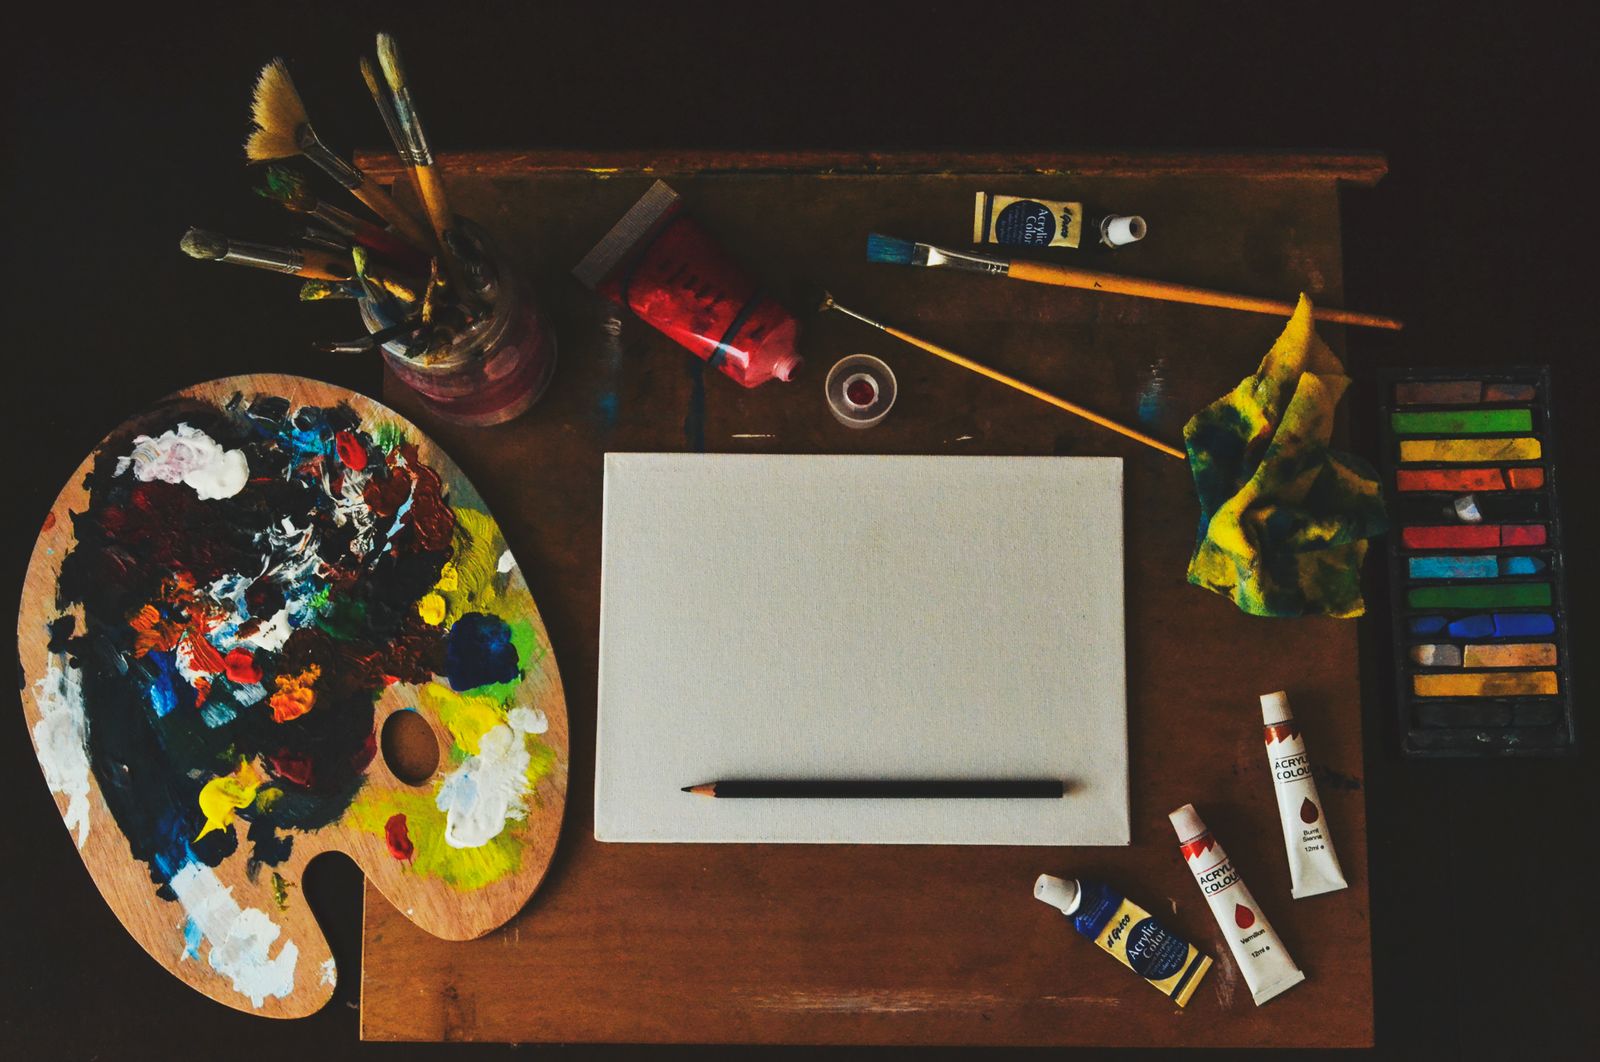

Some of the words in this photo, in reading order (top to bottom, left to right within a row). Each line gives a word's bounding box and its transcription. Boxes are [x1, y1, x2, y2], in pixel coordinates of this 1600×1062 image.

[1024, 216, 1037, 245] Color
[1035, 208, 1049, 245] Acrylic
[1276, 765, 1311, 780] COLOU
[1304, 844, 1319, 852] 12ml
[1204, 873, 1239, 895] COLOU
[1128, 921, 1158, 960] Acrylic
[1142, 929, 1167, 960] Color
[1251, 946, 1265, 958] 12ml
